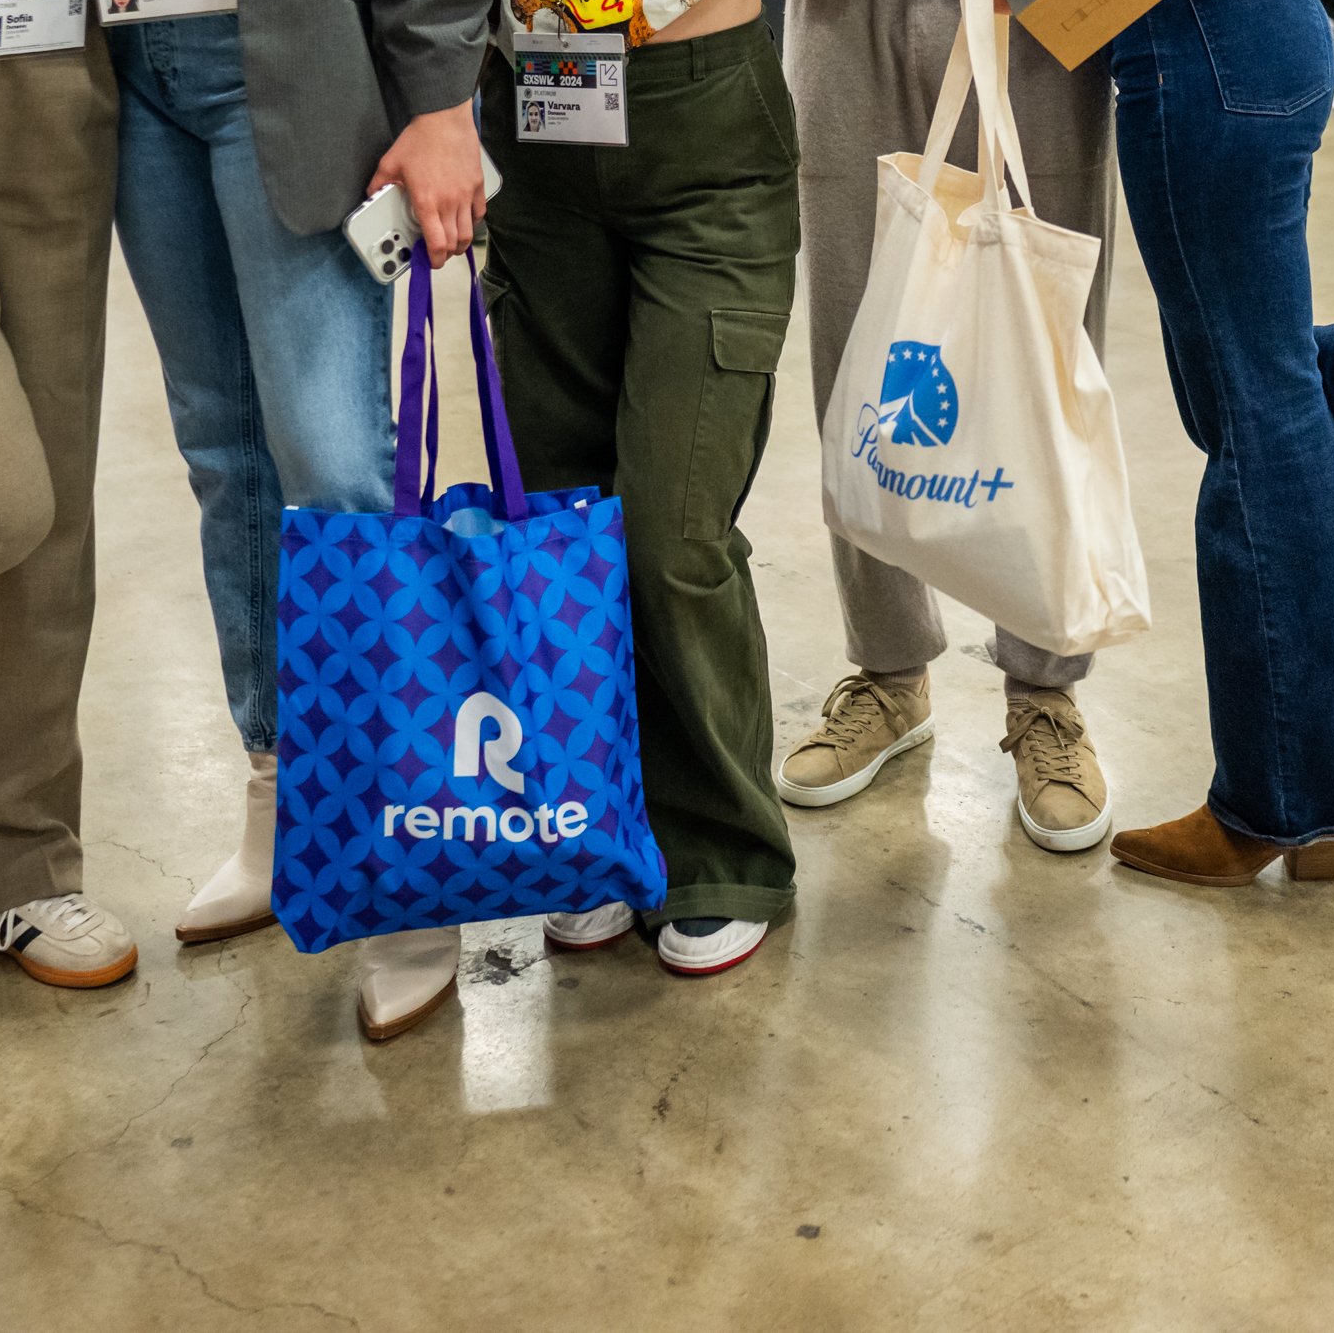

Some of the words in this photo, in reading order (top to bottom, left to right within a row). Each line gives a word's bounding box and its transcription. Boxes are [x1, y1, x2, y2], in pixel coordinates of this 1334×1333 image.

[523, 74, 547, 85] SXSW
[559, 75, 582, 86] 2024
[548, 101, 581, 111] Varvara
[851, 403, 1014, 508] Paramount+
[453, 691, 525, 795] R
[384, 800, 589, 844] remote
